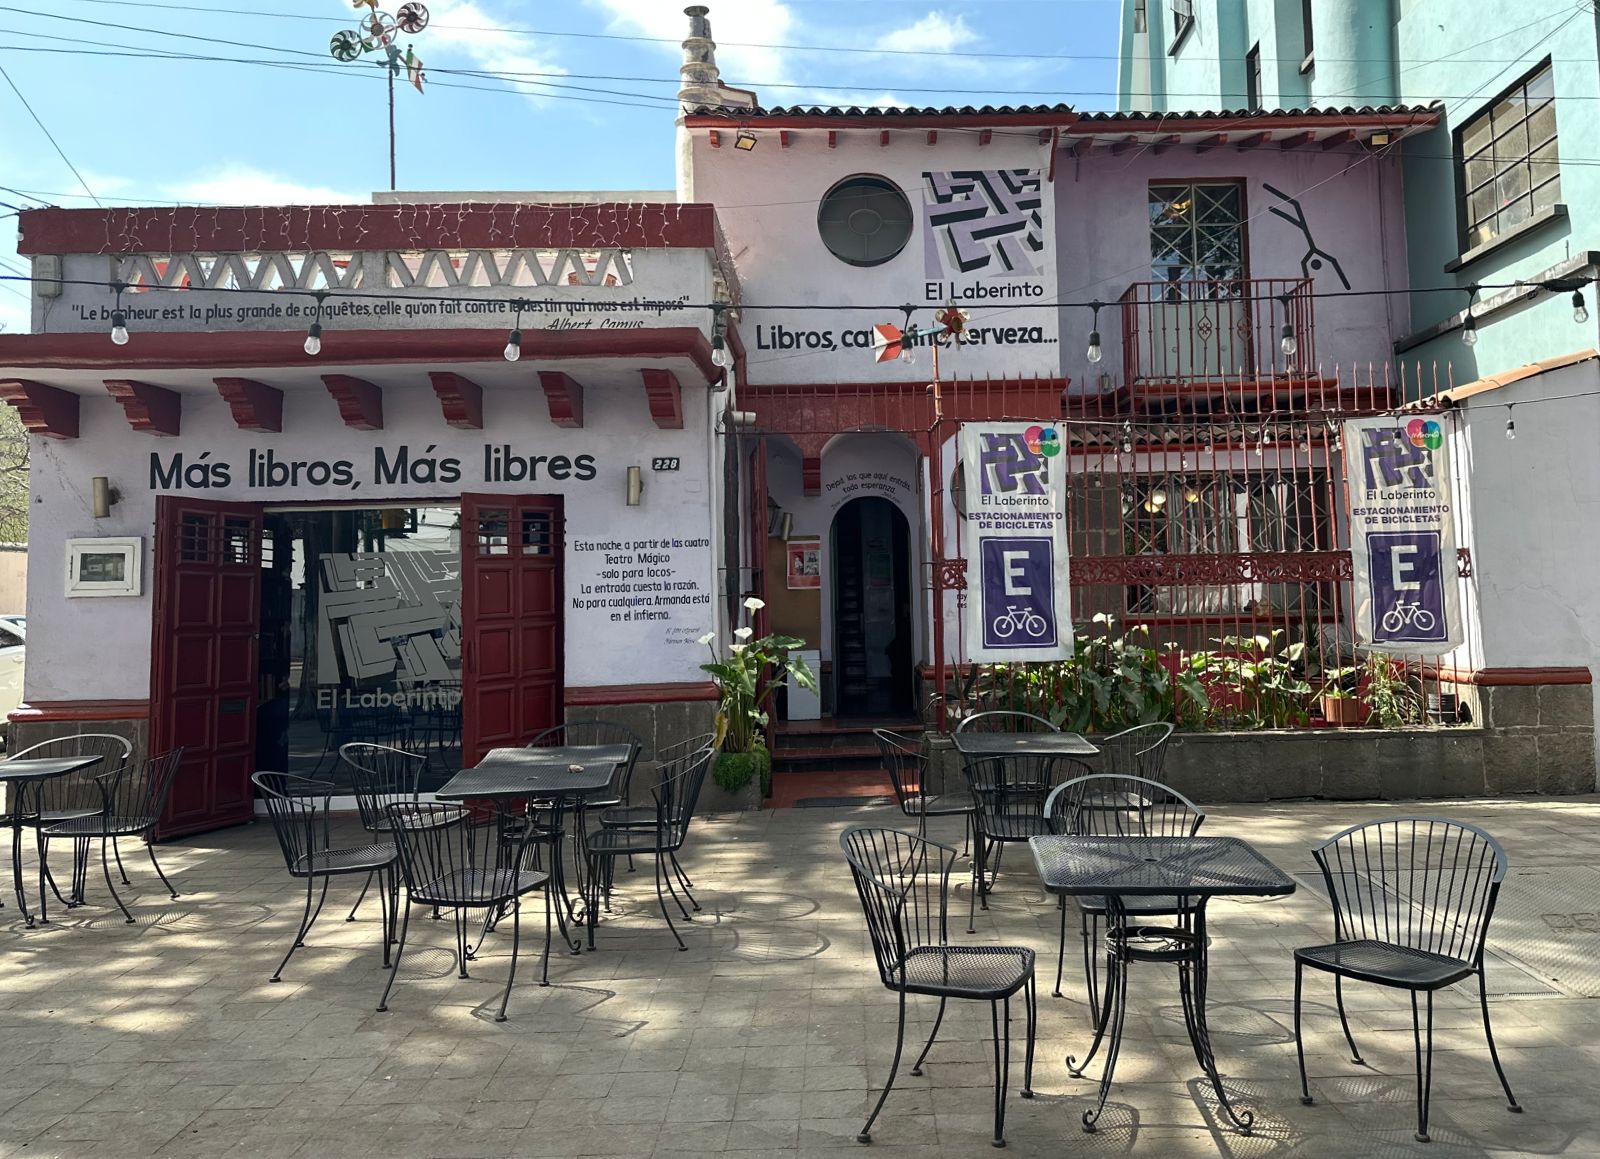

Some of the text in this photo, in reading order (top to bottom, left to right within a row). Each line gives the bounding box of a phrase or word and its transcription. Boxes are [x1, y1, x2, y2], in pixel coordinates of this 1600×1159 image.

[926, 281, 1044, 300] El Laberinto
[71, 304, 97, 320] "Le
[162, 305, 185, 320] est
[190, 305, 201, 319] la
[206, 304, 233, 324] plus
[237, 303, 282, 322] grande
[286, 303, 300, 317] de
[374, 302, 401, 316] celle
[405, 301, 437, 318] qu'on
[439, 300, 462, 314] fait
[465, 300, 506, 314] contre
[757, 325, 838, 351] Libros,
[149, 444, 597, 490] Más libros, Más libres
[654, 459, 678, 469] 228
[981, 495, 1049, 506] El Laberinto
[1366, 489, 1436, 500] El Laberinto
[968, 512, 1063, 521] ESTACIONAMIENTO
[1353, 505, 1450, 516] ESTACIONAMIENTO
[979, 521, 1054, 529] DE BICICLETAS
[1365, 514, 1441, 525] DE BICICLETAS
[574, 540, 594, 551] Esta
[633, 539, 659, 551] partir
[660, 539, 670, 548] de
[671, 538, 683, 548] las
[684, 538, 709, 548] cuatro
[604, 553, 670, 566] Teatro Mágico
[1002, 551, 1031, 596] E
[1391, 545, 1421, 590] E
[622, 569, 643, 581] para
[581, 580, 699, 594] La entrada cuesta la razón.
[572, 597, 584, 609] No
[586, 598, 606, 610] para
[654, 595, 690, 606] Armanda
[692, 593, 710, 604] está
[610, 613, 621, 621] en
[624, 610, 631, 621] el
[317, 687, 463, 709] El Laberinto
